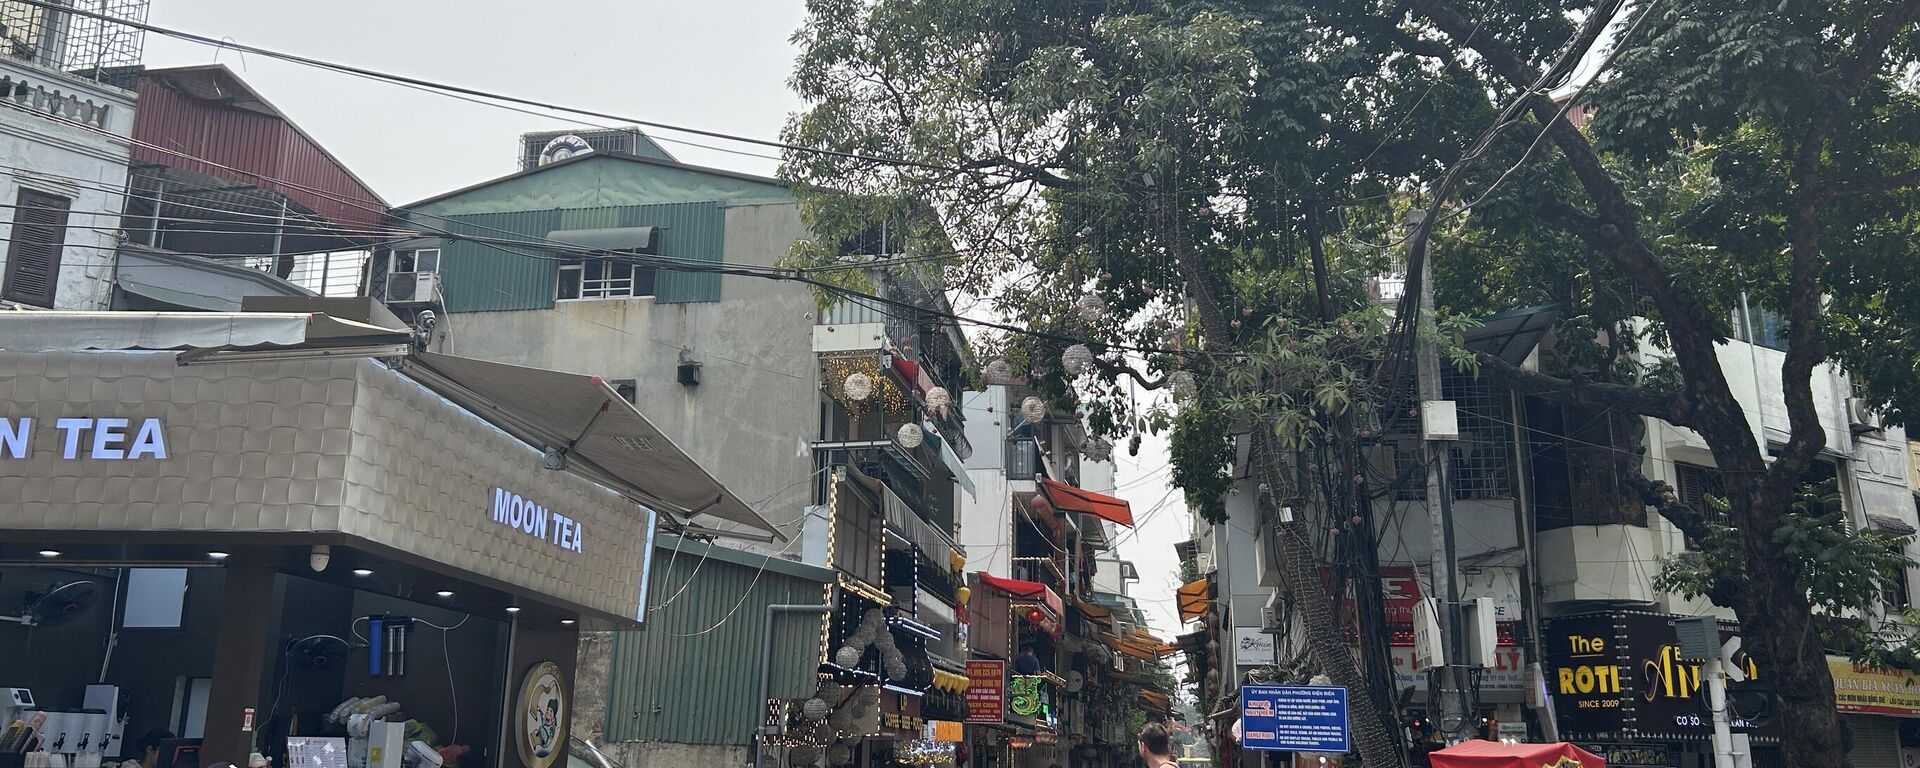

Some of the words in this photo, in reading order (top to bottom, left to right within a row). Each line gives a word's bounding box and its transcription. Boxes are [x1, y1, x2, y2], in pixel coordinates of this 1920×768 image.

[56, 417, 167, 460] TEA
[493, 487, 548, 540] MOON
[553, 512, 582, 554] TEA
[1568, 635, 1604, 653] The
[1558, 665, 1620, 694] ROTI
[1862, 679, 1878, 691] BIA
[1578, 700, 1599, 708] SINCE
[1602, 699, 1619, 708] 2009
